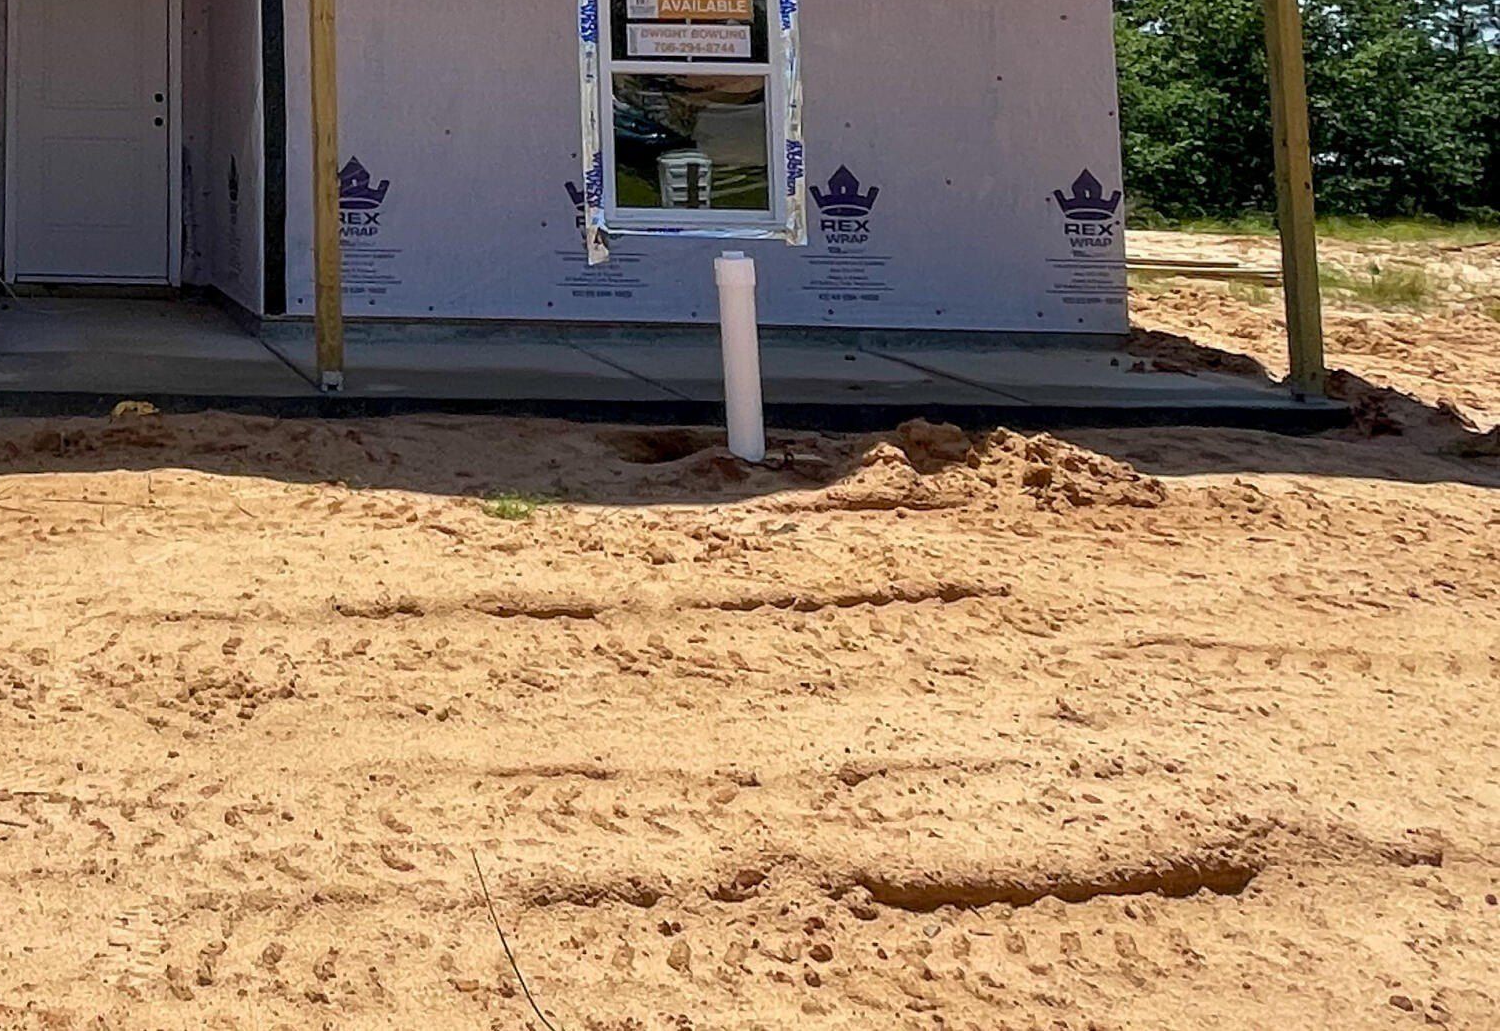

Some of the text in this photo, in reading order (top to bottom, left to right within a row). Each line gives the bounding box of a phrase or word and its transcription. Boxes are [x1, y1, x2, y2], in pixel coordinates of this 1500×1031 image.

[661, 0, 749, 13] AVAILABLE
[640, 28, 747, 40] DWIGHT BOWLING
[820, 219, 870, 232] REX
[1064, 223, 1114, 236] REX
[826, 233, 869, 244] WRAP
[1070, 237, 1113, 248] WRAP
